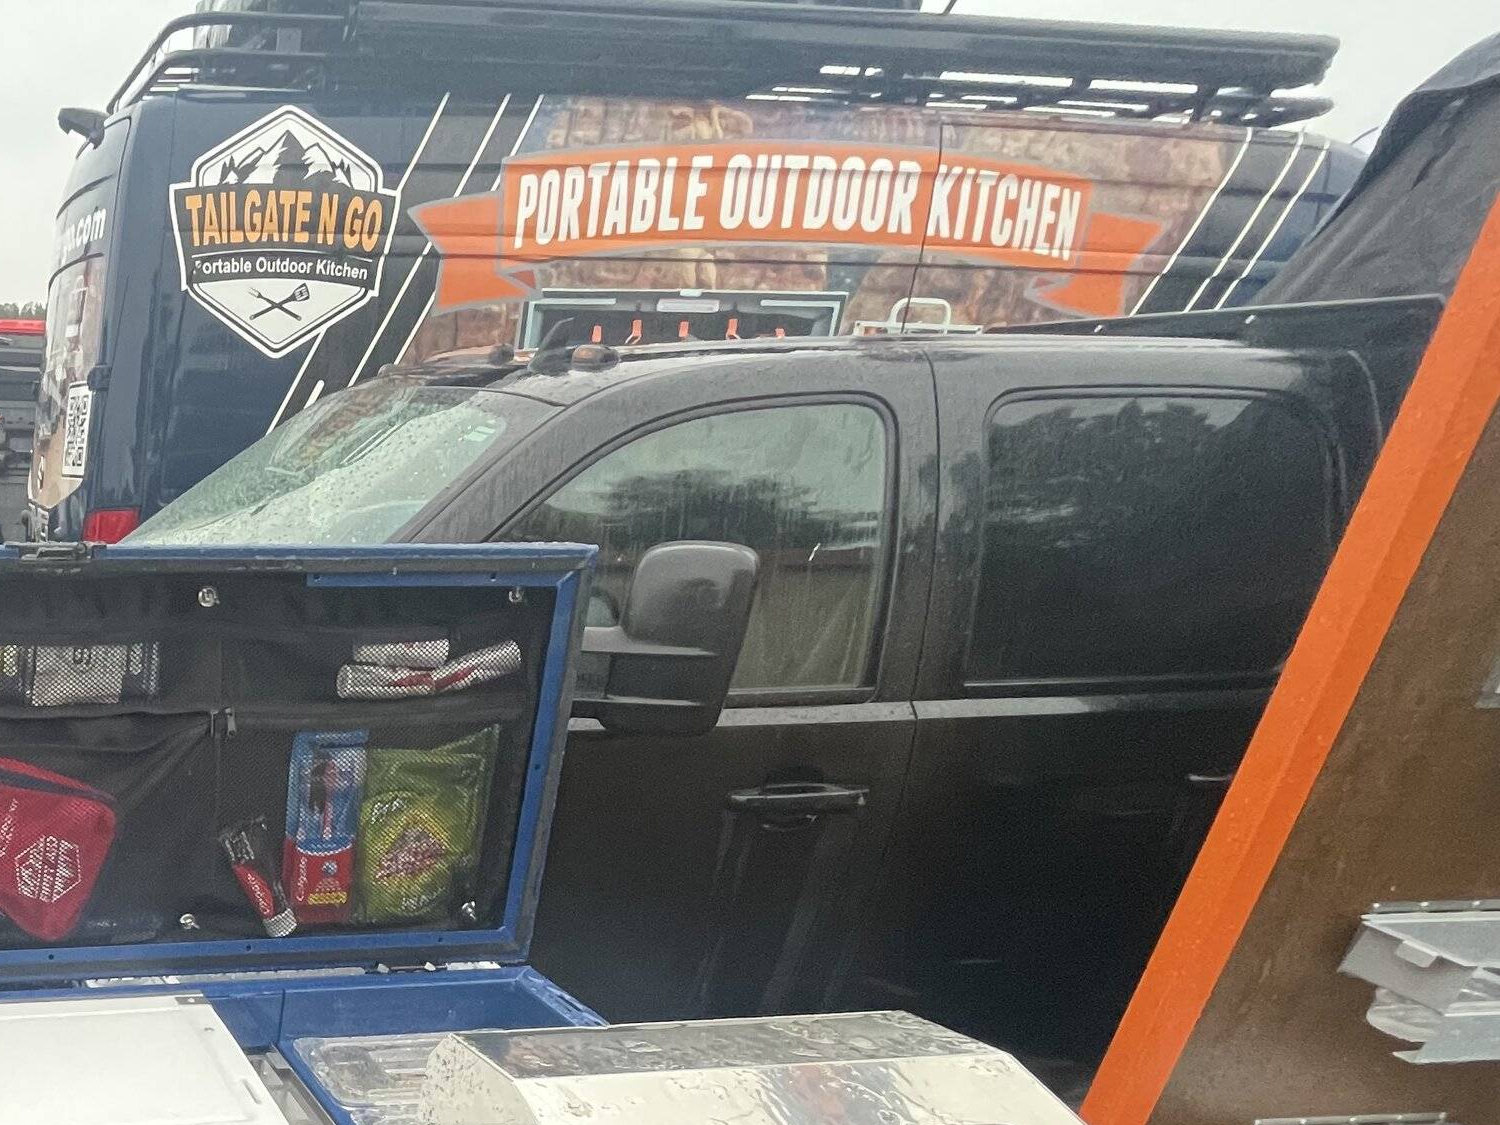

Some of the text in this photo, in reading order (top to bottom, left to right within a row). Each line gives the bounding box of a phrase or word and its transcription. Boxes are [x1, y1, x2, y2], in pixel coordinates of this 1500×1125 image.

[185, 189, 383, 253] TAILGATE N GO
[513, 153, 1081, 262] PORTABLE OUTDOOR KITCHEN
[255, 256, 313, 274] Outdoor
[316, 259, 368, 280] Kitchen
